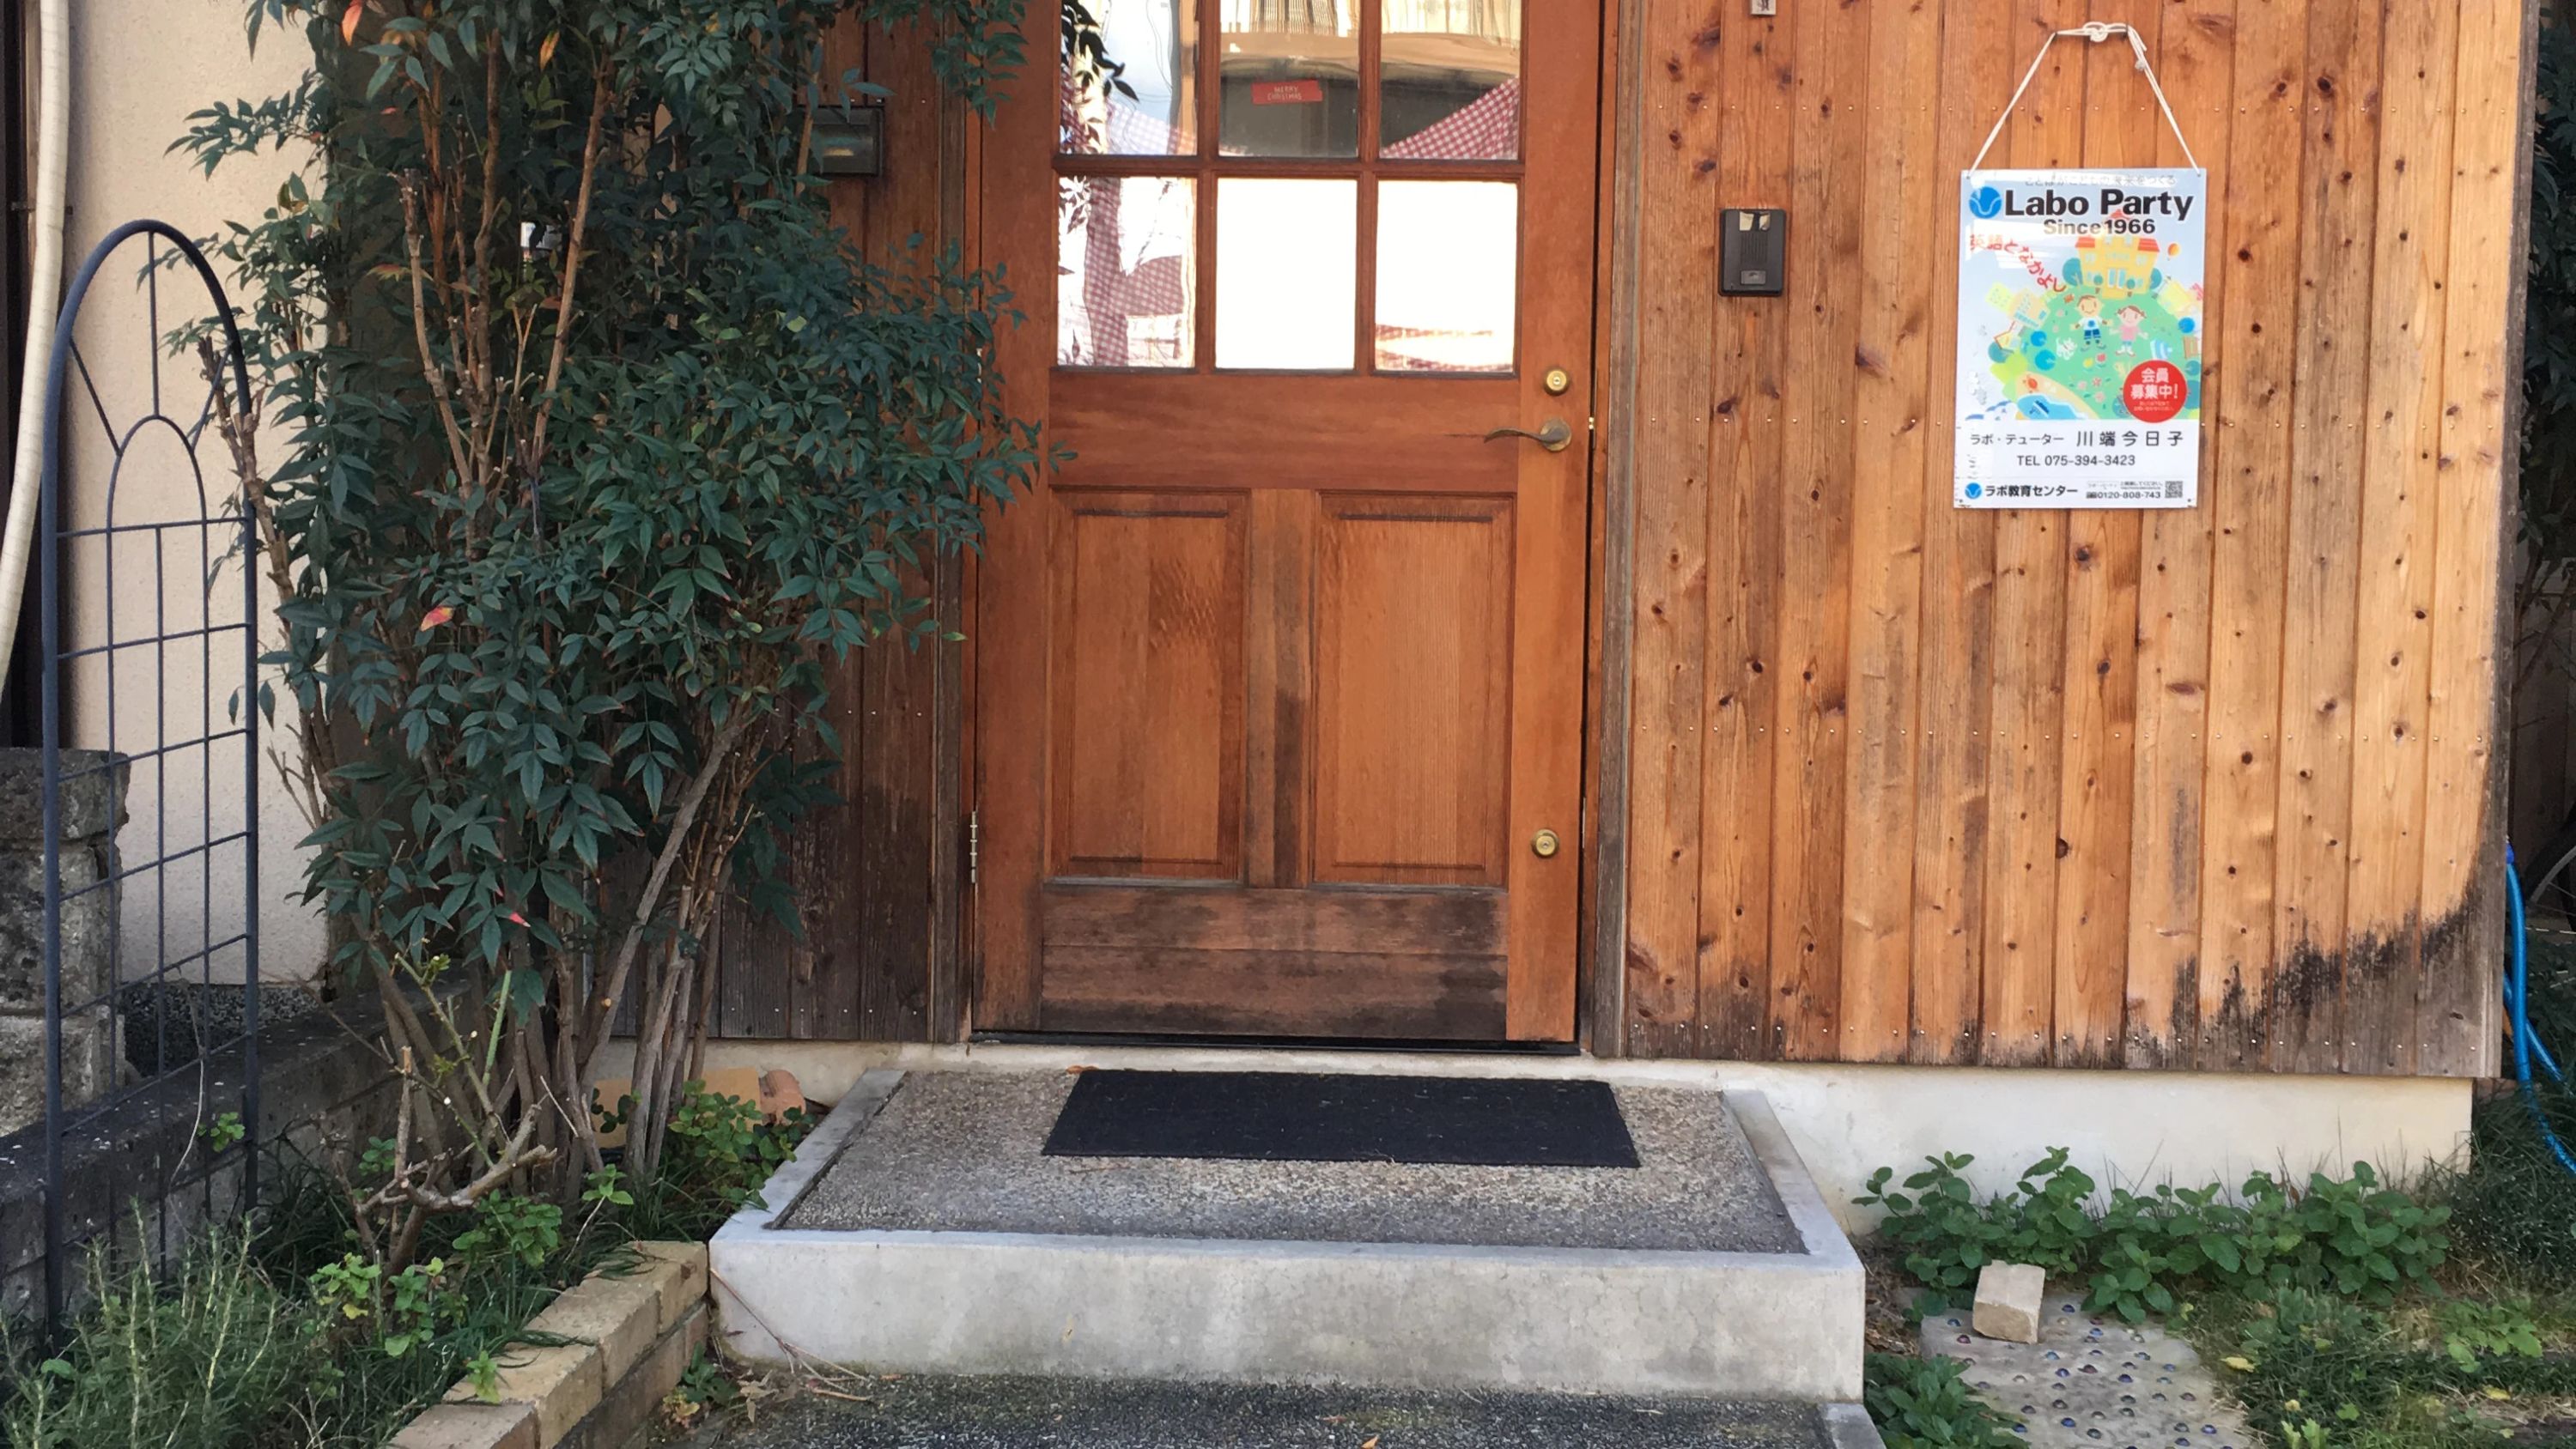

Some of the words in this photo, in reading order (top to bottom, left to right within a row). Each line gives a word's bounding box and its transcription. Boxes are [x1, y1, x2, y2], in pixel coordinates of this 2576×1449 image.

[2005, 189, 2089, 216] Labo
[2100, 188, 2194, 221] Party
[2141, 367, 2169, 384] 会員
[2017, 455, 2041, 466] TEL
[2044, 455, 2136, 466] 075-394-3423
[1985, 485, 2078, 498] ラボ教育センター
